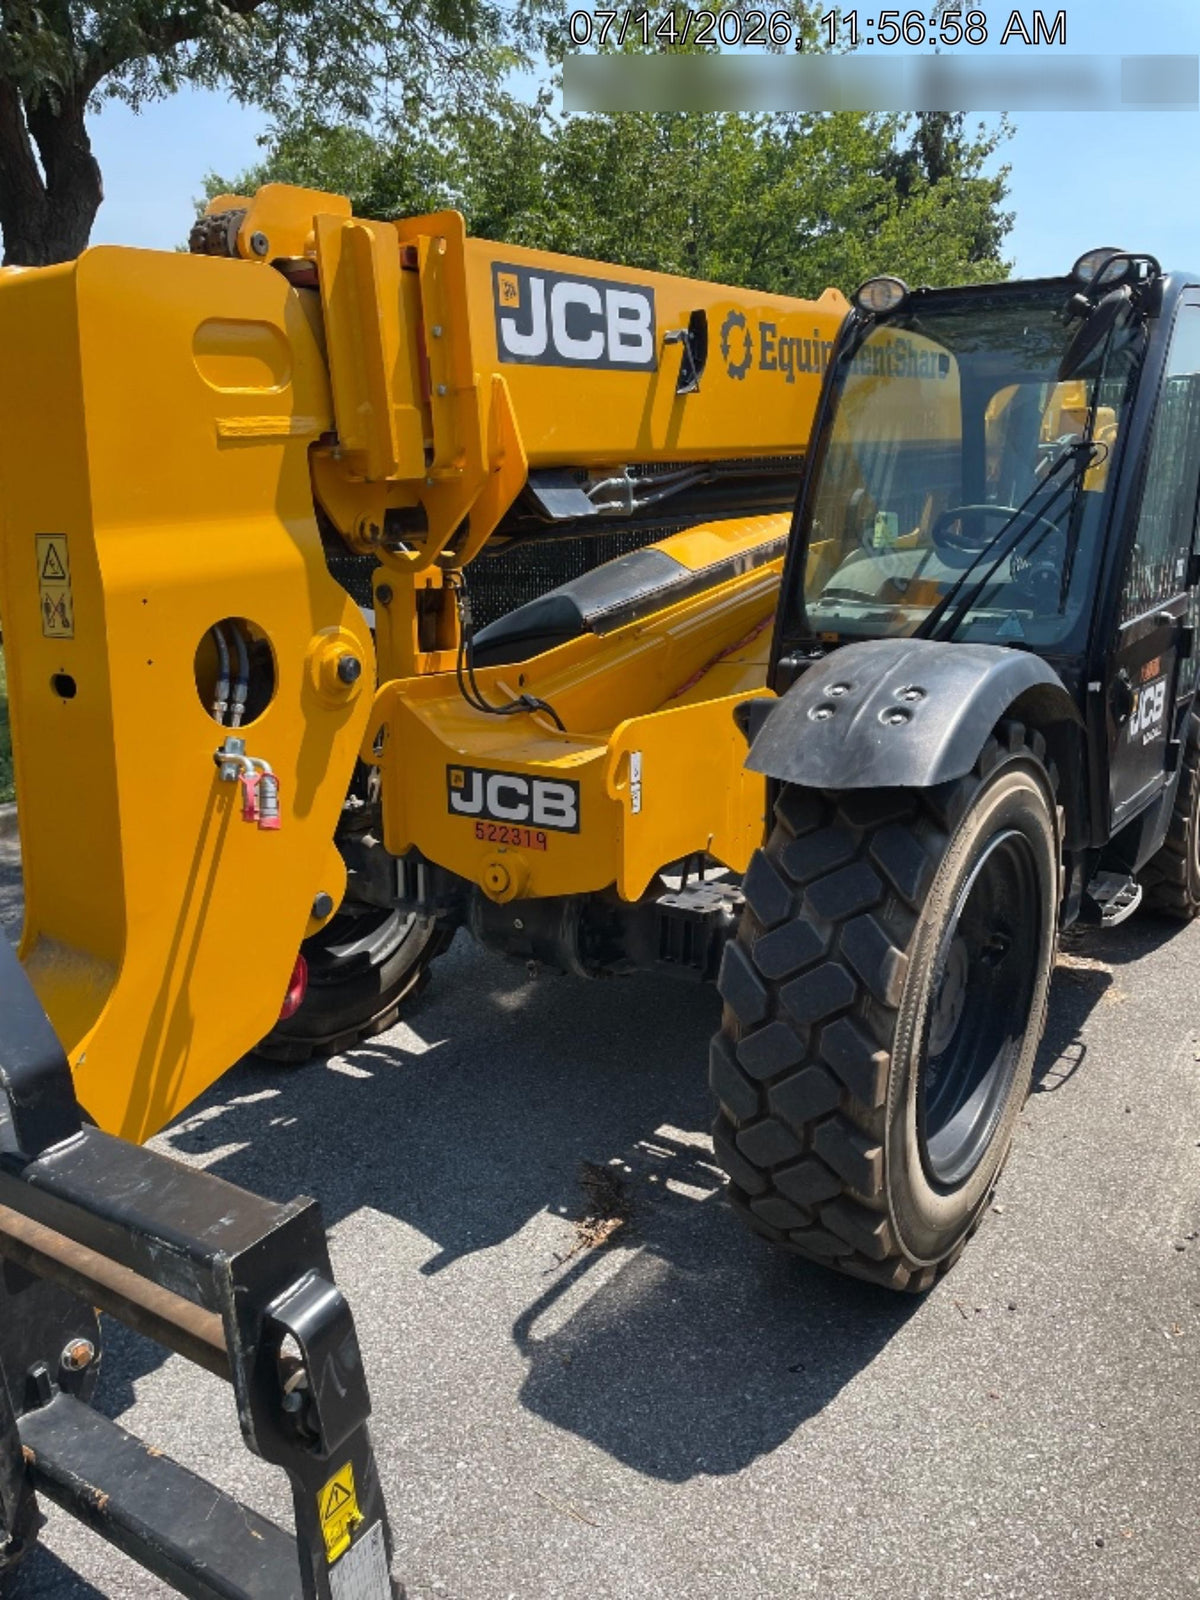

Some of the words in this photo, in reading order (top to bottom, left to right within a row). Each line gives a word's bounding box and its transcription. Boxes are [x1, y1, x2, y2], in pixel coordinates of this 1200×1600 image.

[501, 276, 655, 363] JCB
[1130, 680, 1166, 736] JCB
[451, 771, 577, 828] JCB
[475, 821, 547, 851] 522319
